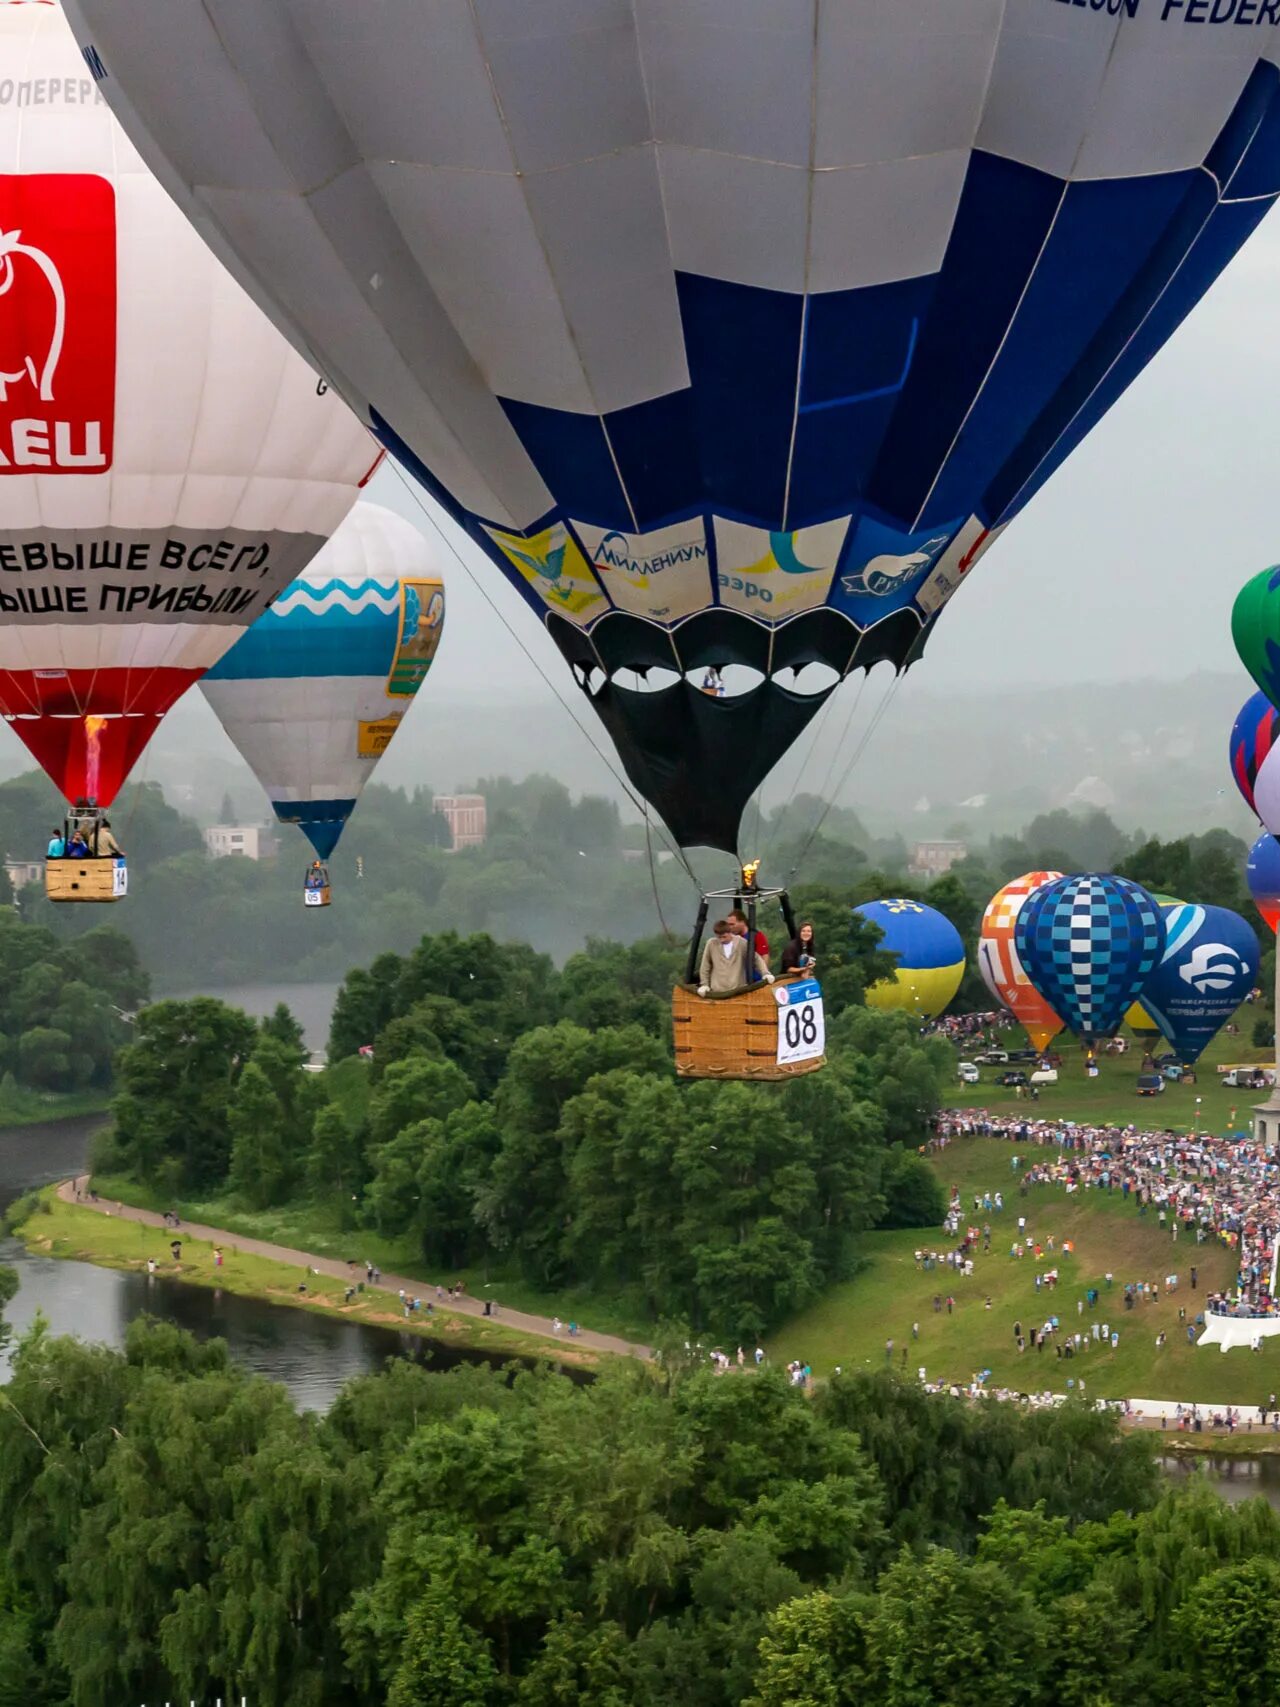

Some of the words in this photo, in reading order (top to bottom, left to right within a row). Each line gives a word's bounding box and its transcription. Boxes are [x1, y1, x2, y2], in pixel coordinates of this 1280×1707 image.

[593, 541, 708, 576] МИЛЛЕНИУМ
[100, 583, 258, 614] ПРИБЫЛИ
[785, 1004, 817, 1049] 08
